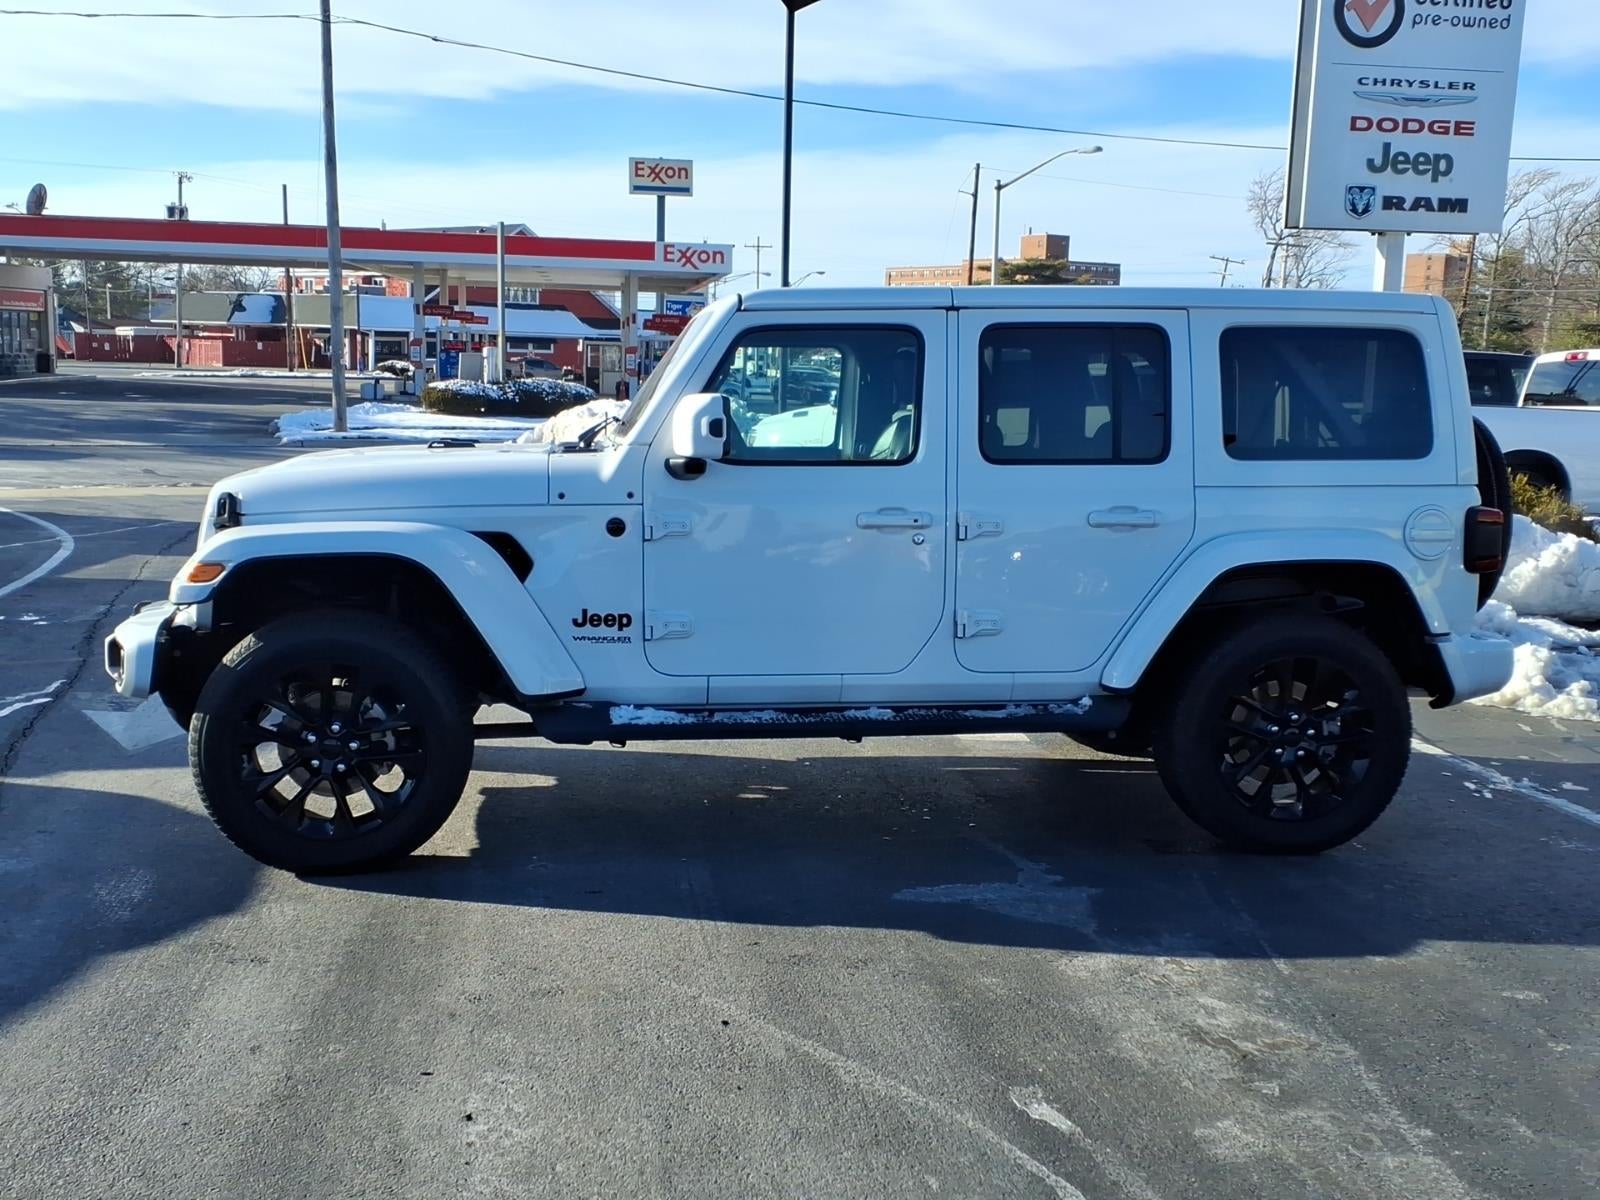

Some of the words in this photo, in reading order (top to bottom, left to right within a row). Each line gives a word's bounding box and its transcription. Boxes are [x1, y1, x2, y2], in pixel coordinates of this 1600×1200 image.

[1412, 13, 1512, 30] pre-owned
[1357, 76, 1476, 91] CHRYSLER
[1349, 115, 1476, 137] DODGE
[634, 160, 689, 185] Exxon
[1366, 141, 1454, 183] Jeep
[1381, 195, 1469, 214] RAM
[663, 244, 725, 270] Exxon
[666, 302, 683, 310] Tiger
[571, 608, 632, 631] Jeep
